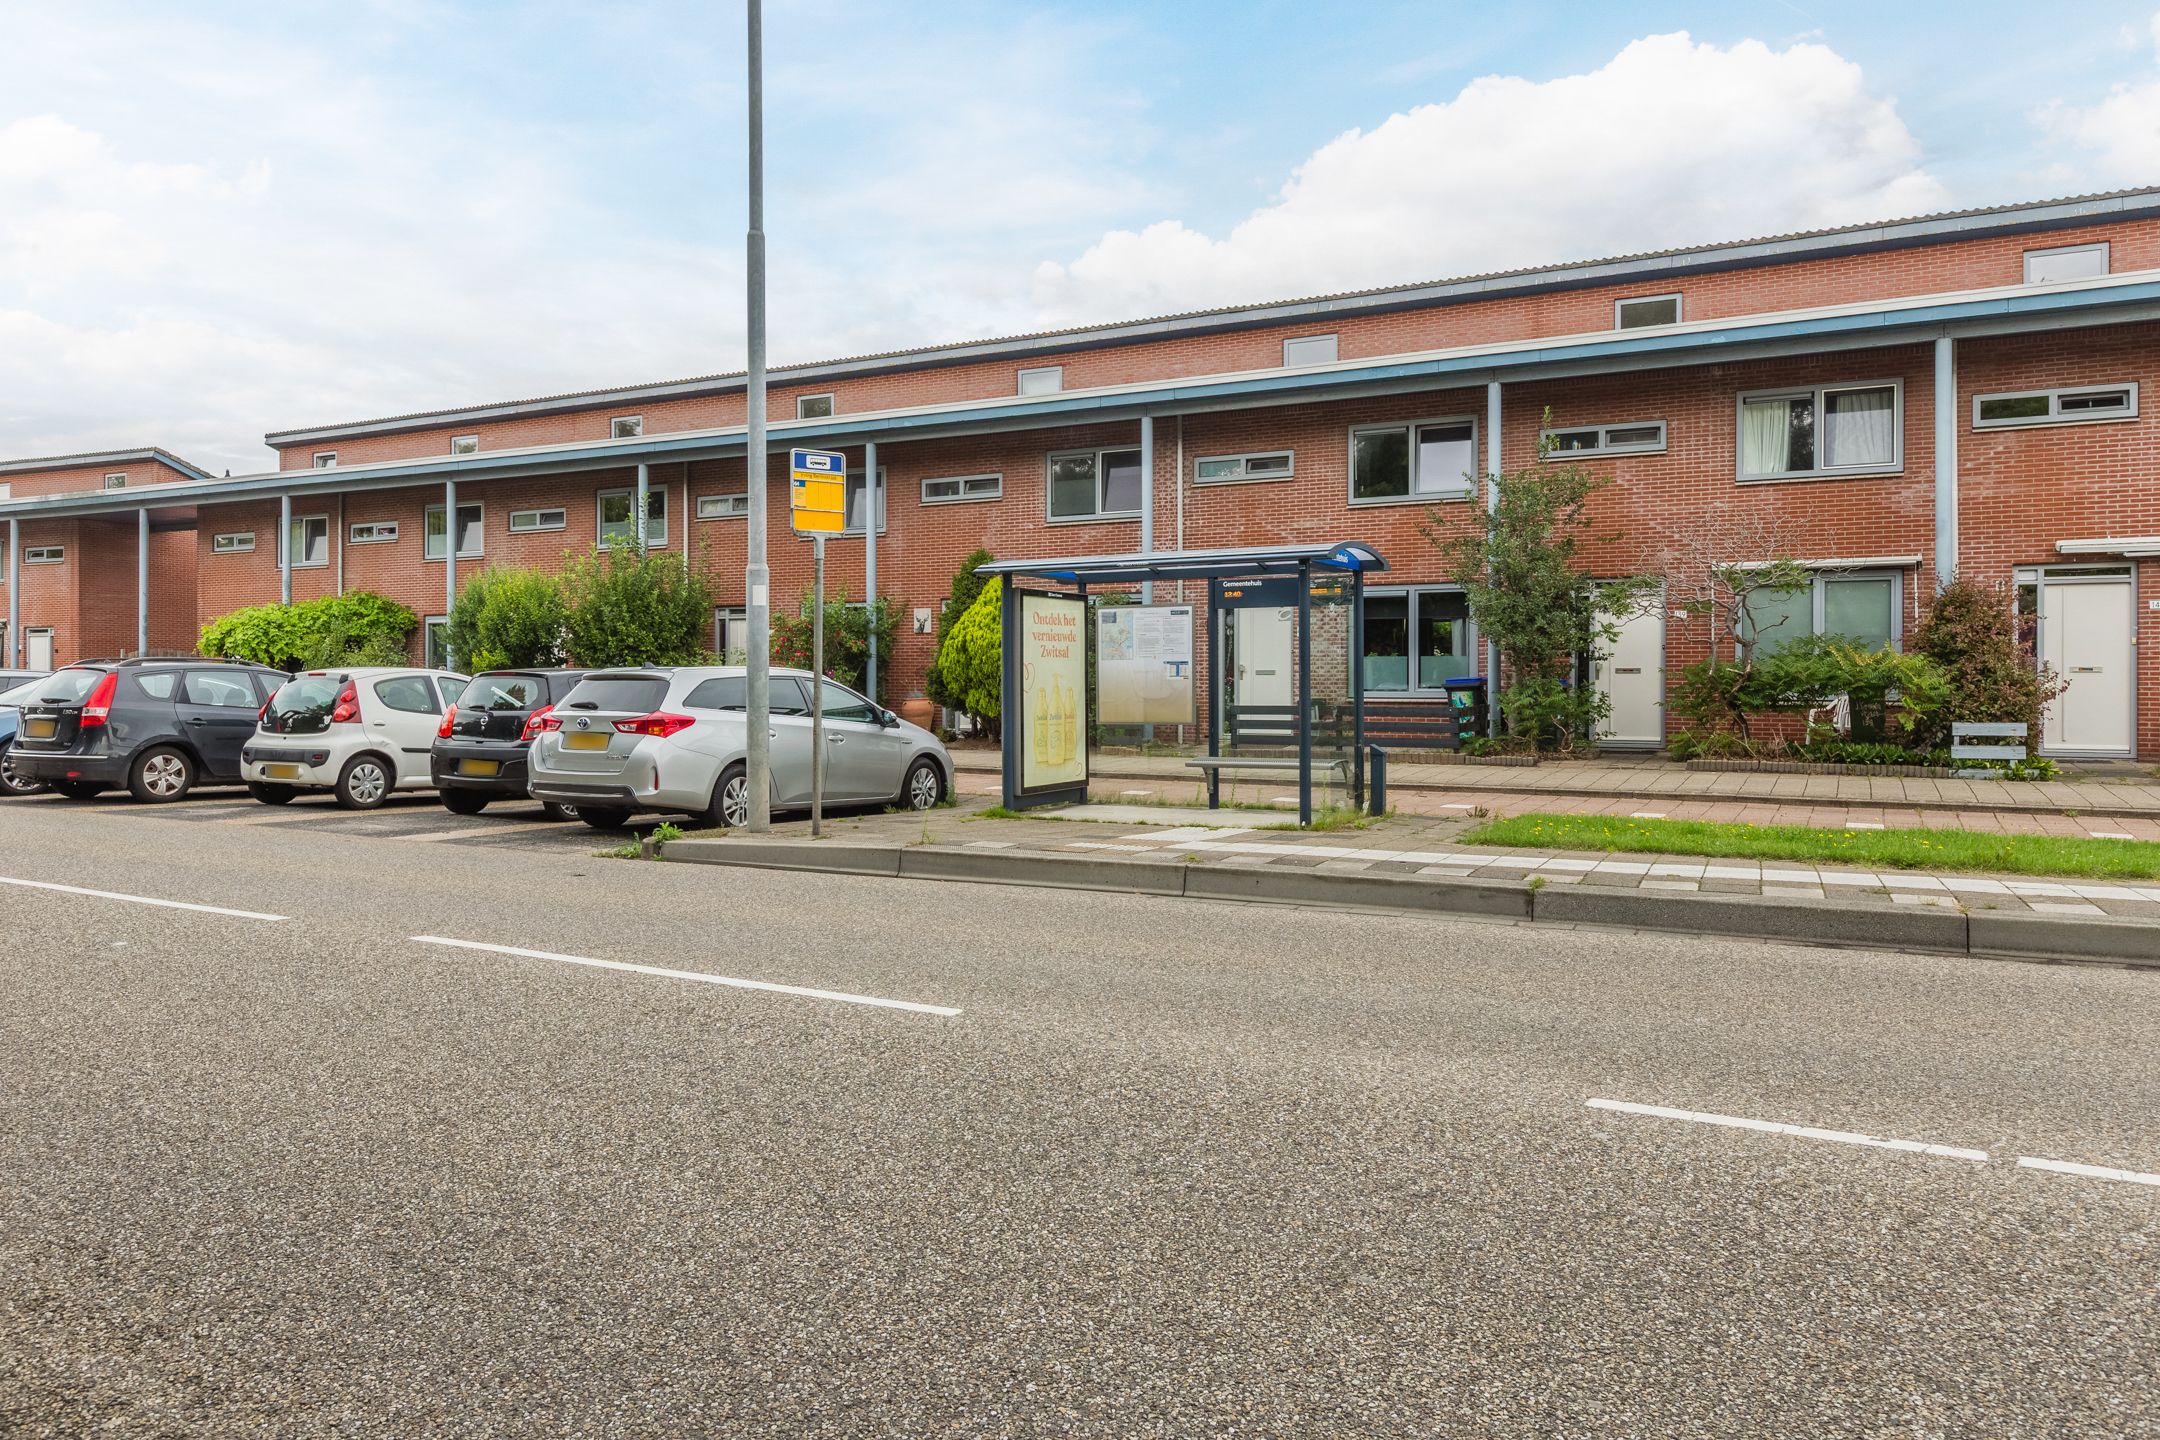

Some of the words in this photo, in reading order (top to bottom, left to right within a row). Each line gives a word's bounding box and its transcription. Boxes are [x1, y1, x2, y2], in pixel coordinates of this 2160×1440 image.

[1033, 611, 1062, 626] Ontdek
[1063, 613, 1076, 626] het
[1032, 628, 1077, 642] vernieuwde
[1040, 644, 1069, 658] Zwitsal
